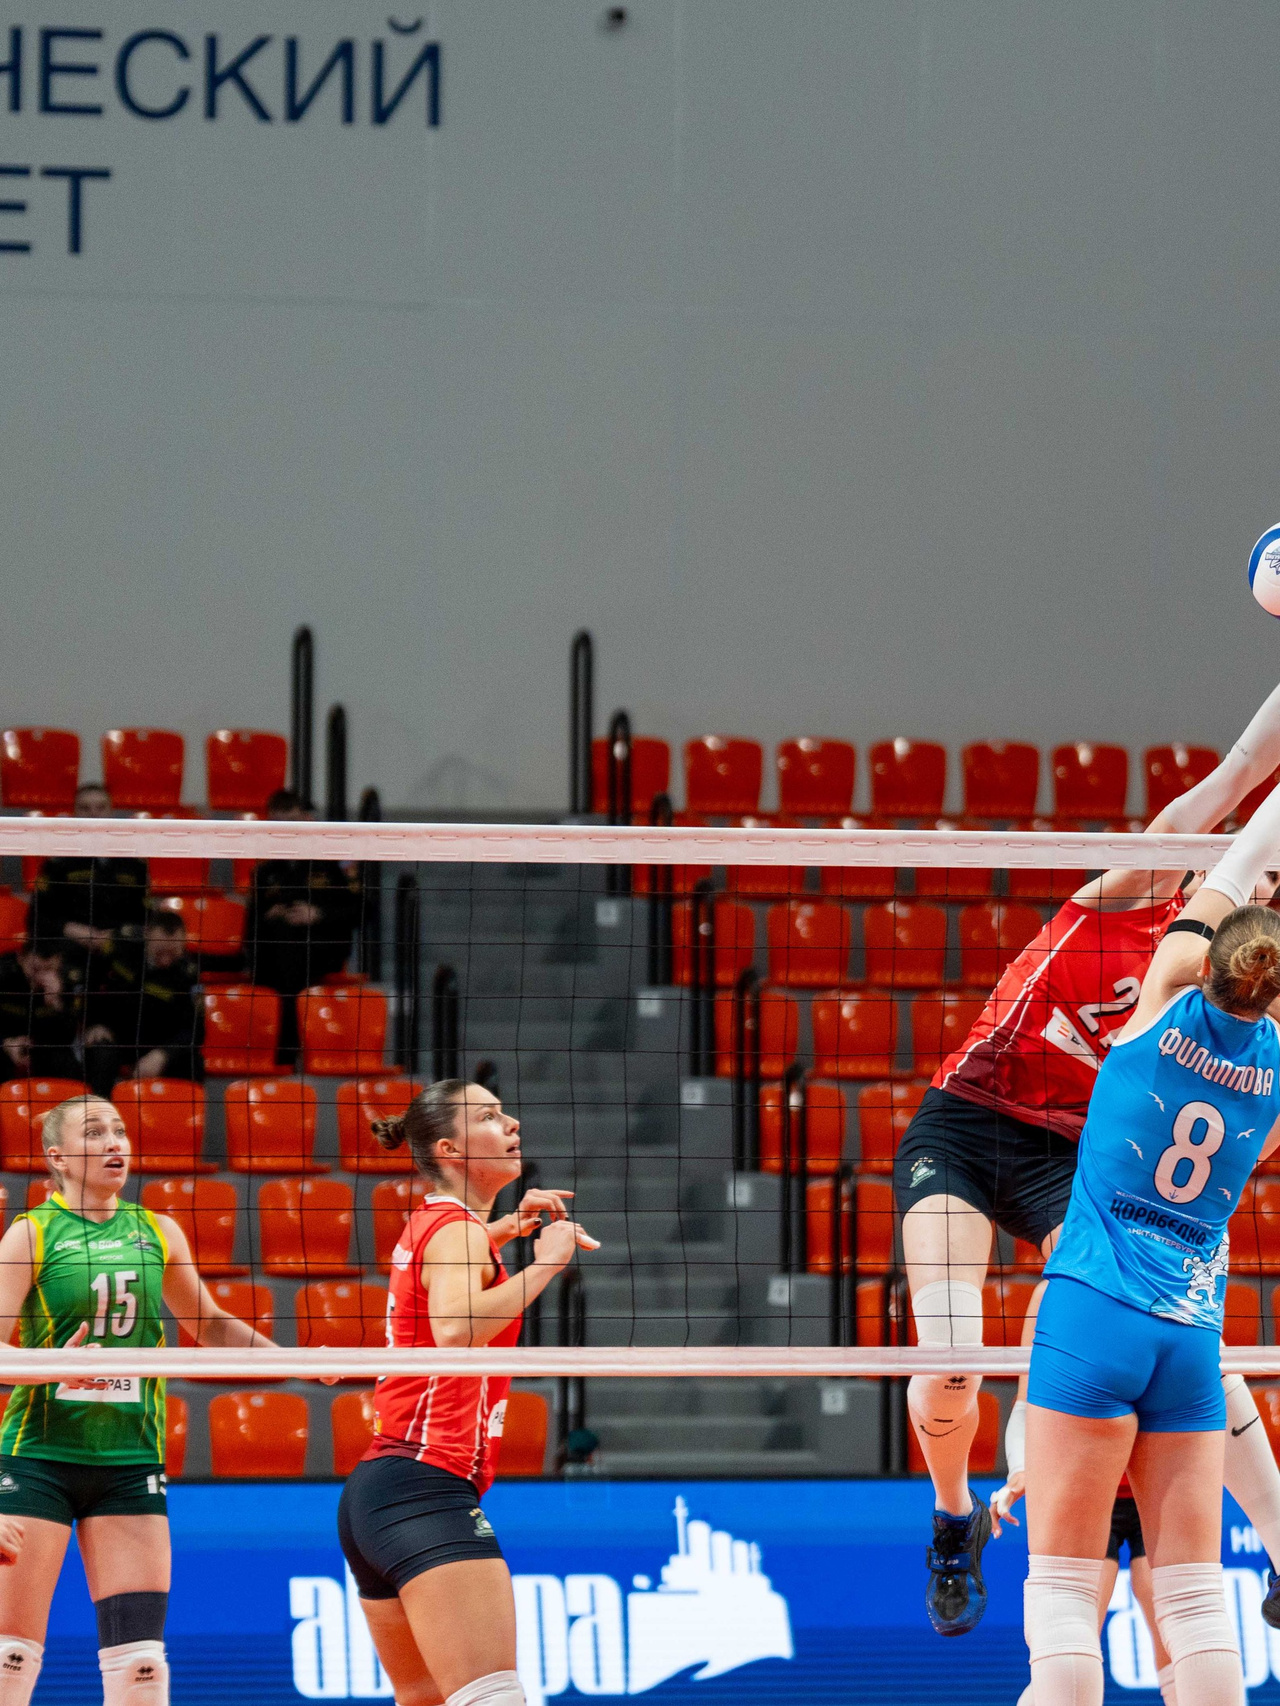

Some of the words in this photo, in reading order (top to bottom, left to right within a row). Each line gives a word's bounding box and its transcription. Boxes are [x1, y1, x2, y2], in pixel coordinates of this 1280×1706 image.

[1077, 976, 1141, 1051] 2
[1157, 1026, 1275, 1097] ФИЛИППОВА
[1153, 1100, 1226, 1205] 8
[90, 1271, 139, 1338] 15
